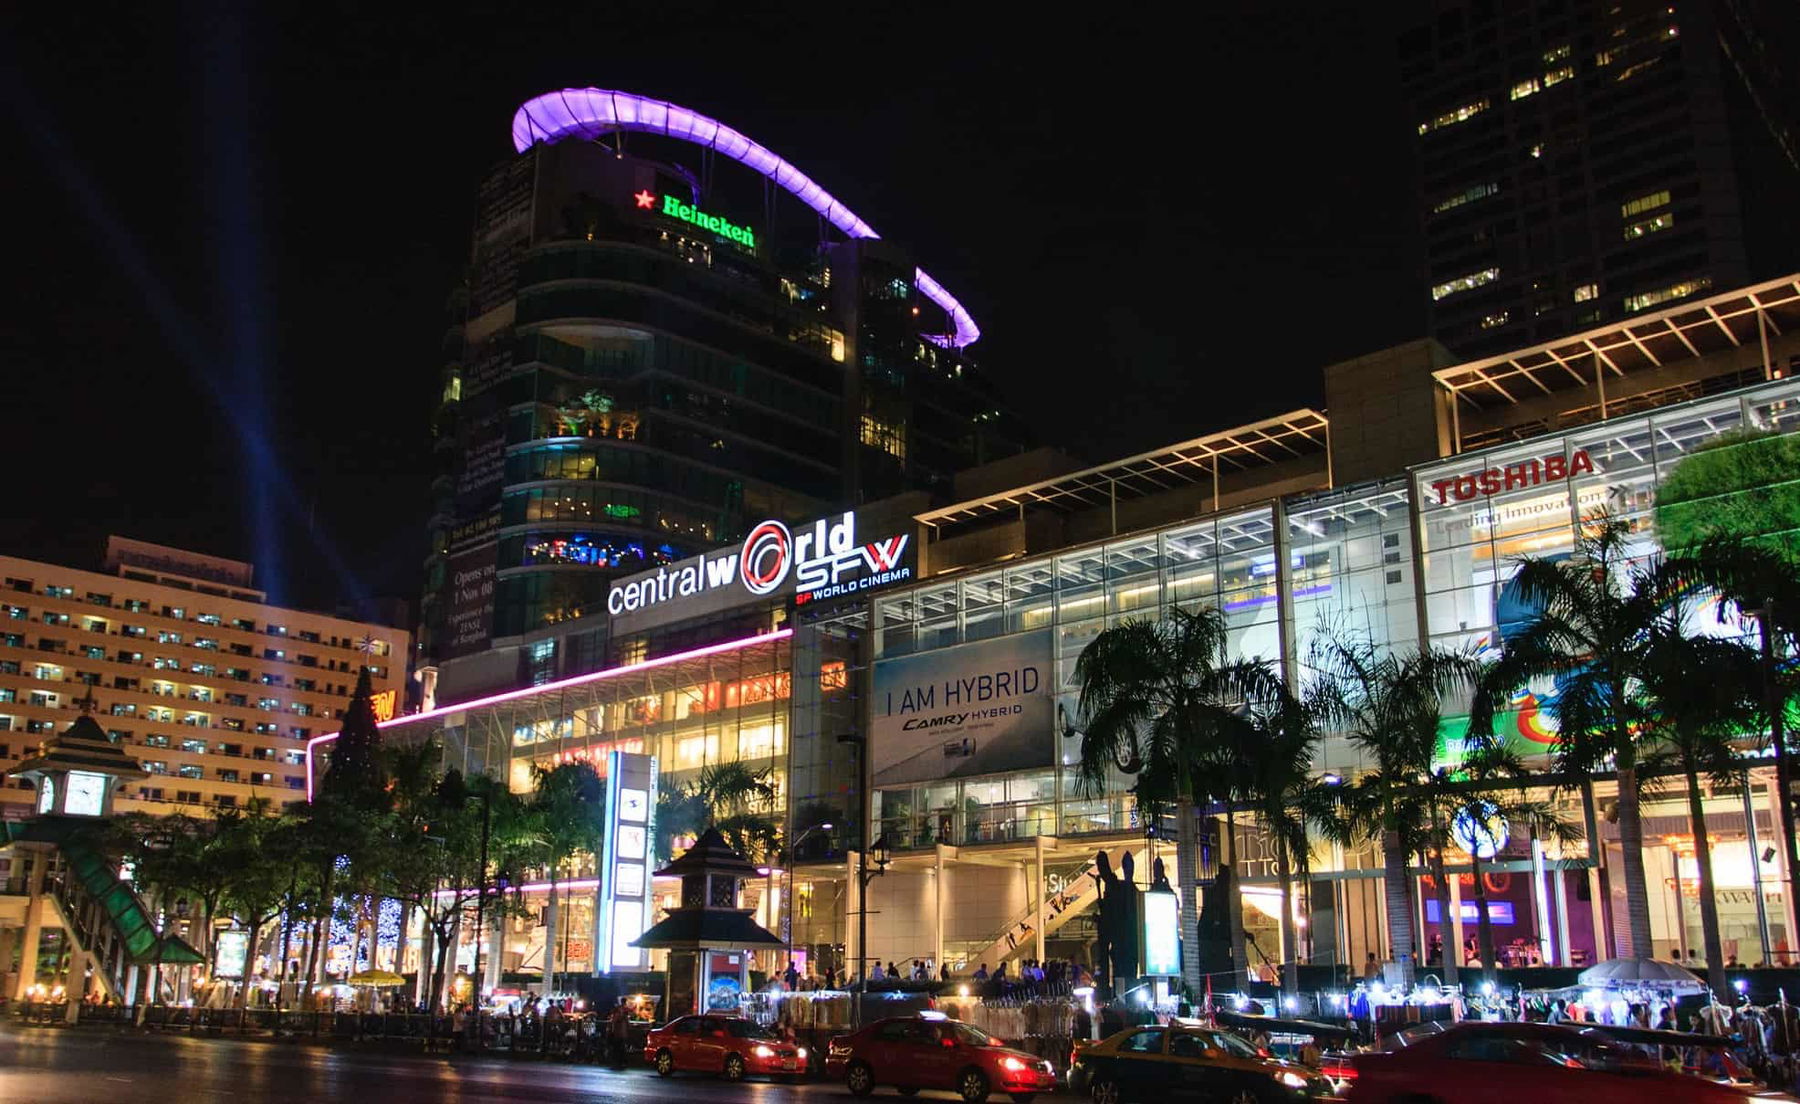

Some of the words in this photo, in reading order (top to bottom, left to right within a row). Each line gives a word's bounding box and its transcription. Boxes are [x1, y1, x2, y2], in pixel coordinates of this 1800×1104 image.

[662, 194, 755, 247] Heineken
[1431, 449, 1594, 505] TOSHIBA
[454, 568, 481, 587] Opens
[461, 588, 479, 602] Nov
[796, 591, 813, 606] SF
[813, 579, 857, 600] WORLD
[859, 567, 911, 589] CINEMA
[886, 691, 892, 717] I
[900, 685, 935, 715] AM
[945, 666, 1039, 707] HYBRID
[901, 711, 970, 732] CAMRY
[971, 704, 1023, 721] HYBRID
